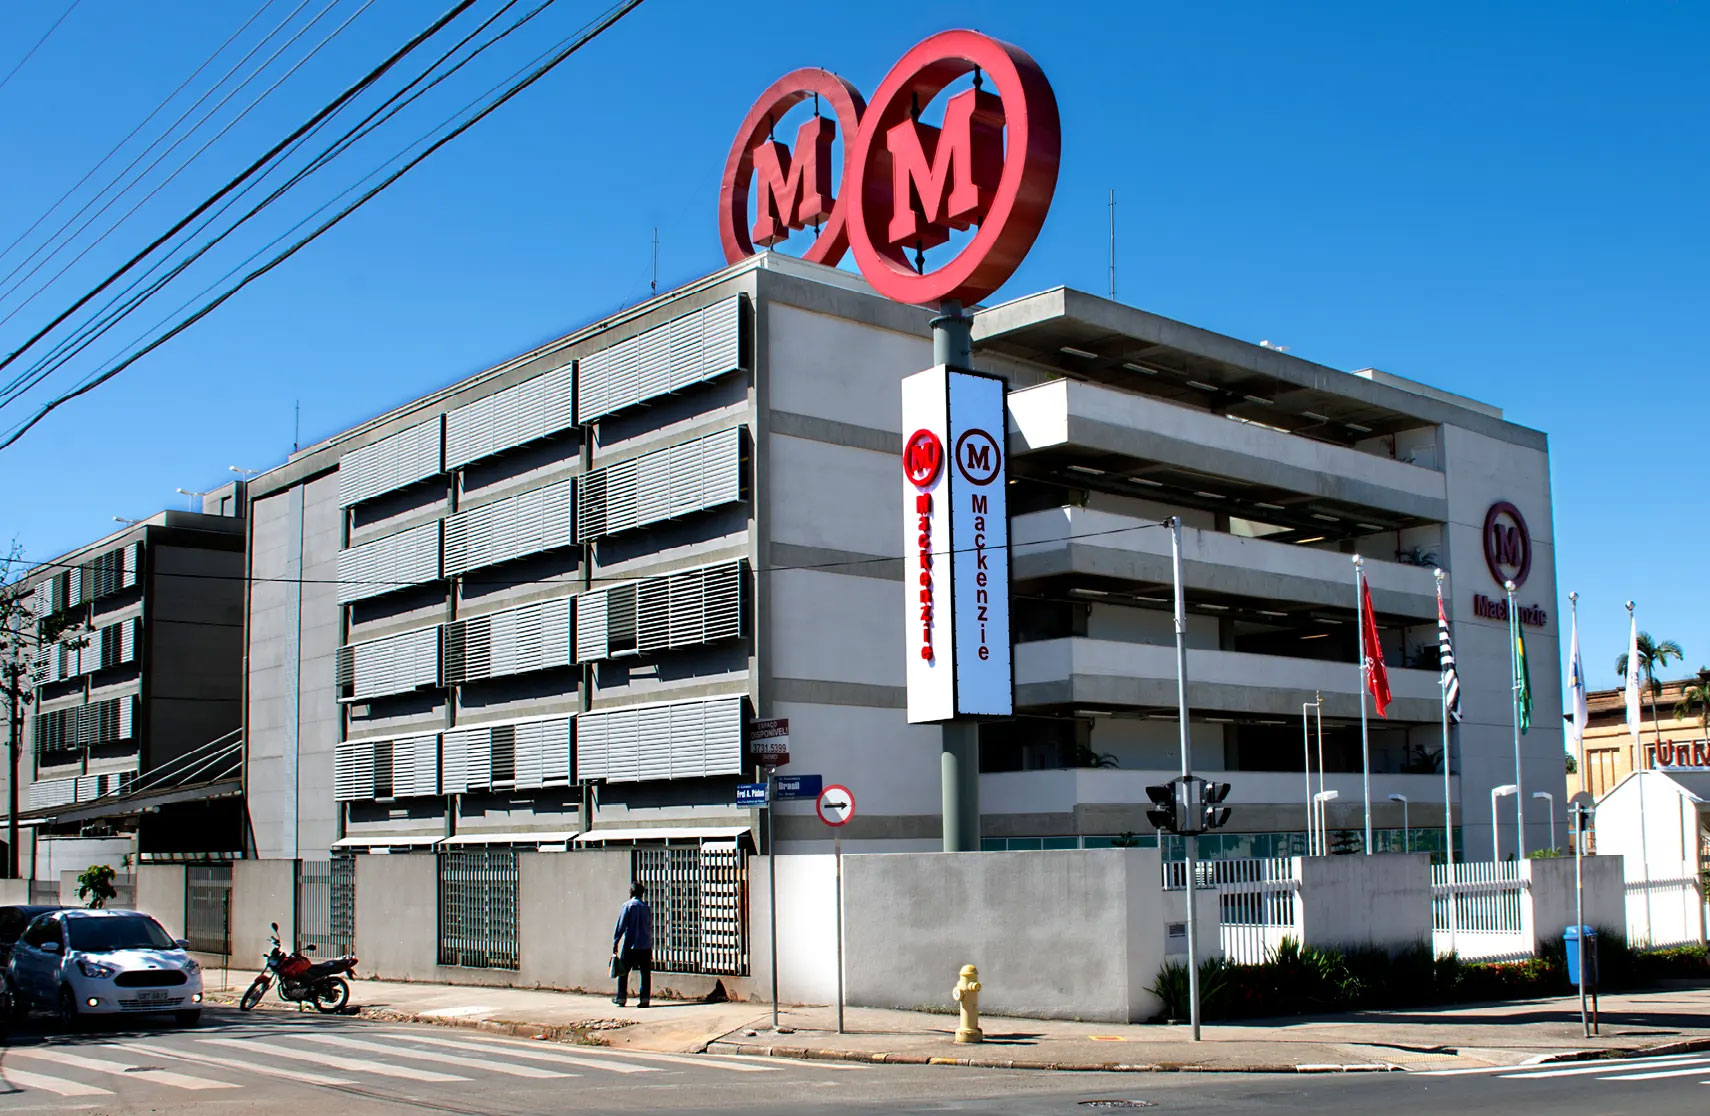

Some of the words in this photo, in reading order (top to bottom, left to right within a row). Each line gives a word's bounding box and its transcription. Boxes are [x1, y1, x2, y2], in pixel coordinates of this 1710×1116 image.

[753, 115, 823, 246] M
[887, 88, 980, 243] M
[915, 493, 934, 661] Mackenzie
[971, 494, 989, 660] Mackenzie
[1473, 593, 1547, 627] Macnzie
[778, 781, 800, 790] Brasil
